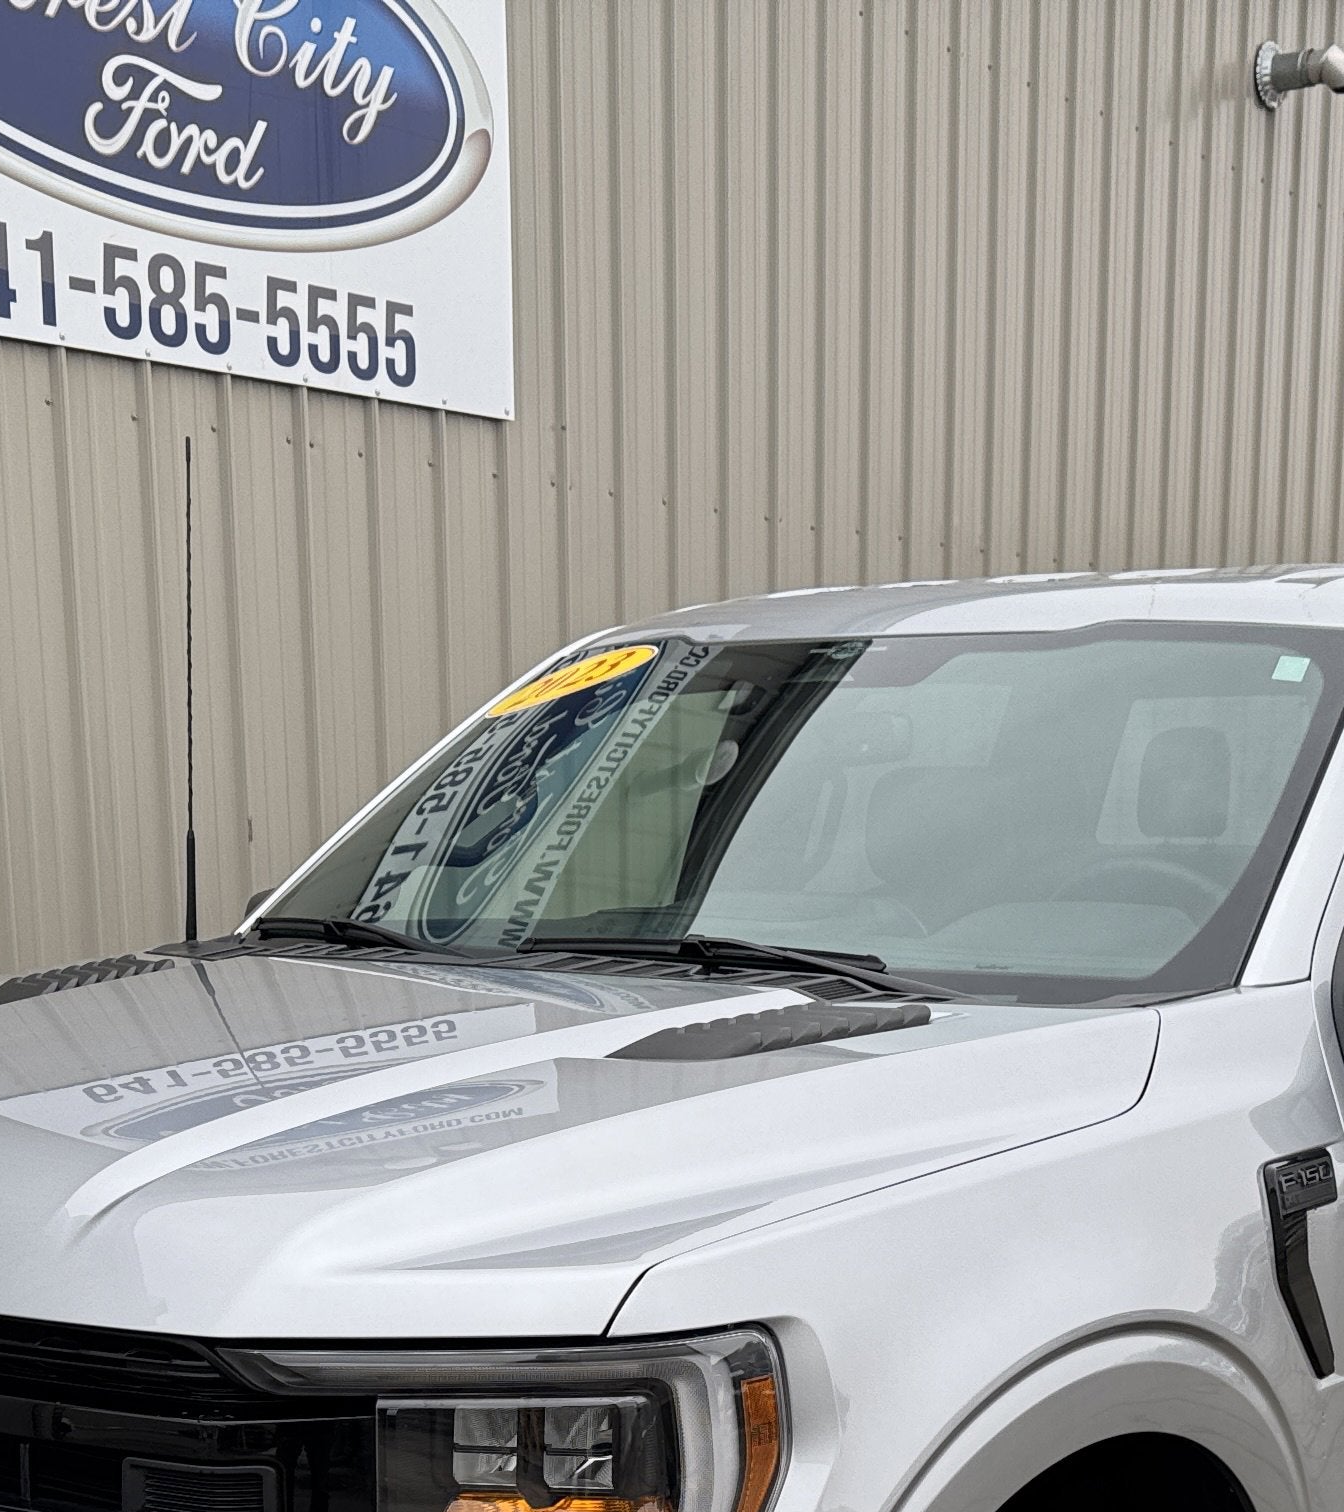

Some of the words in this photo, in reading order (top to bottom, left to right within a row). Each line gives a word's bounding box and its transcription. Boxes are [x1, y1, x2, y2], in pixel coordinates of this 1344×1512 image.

[84, 54, 268, 190] Ford
[233, 0, 398, 145] City
[1279, 1163, 1333, 1192] F-150
